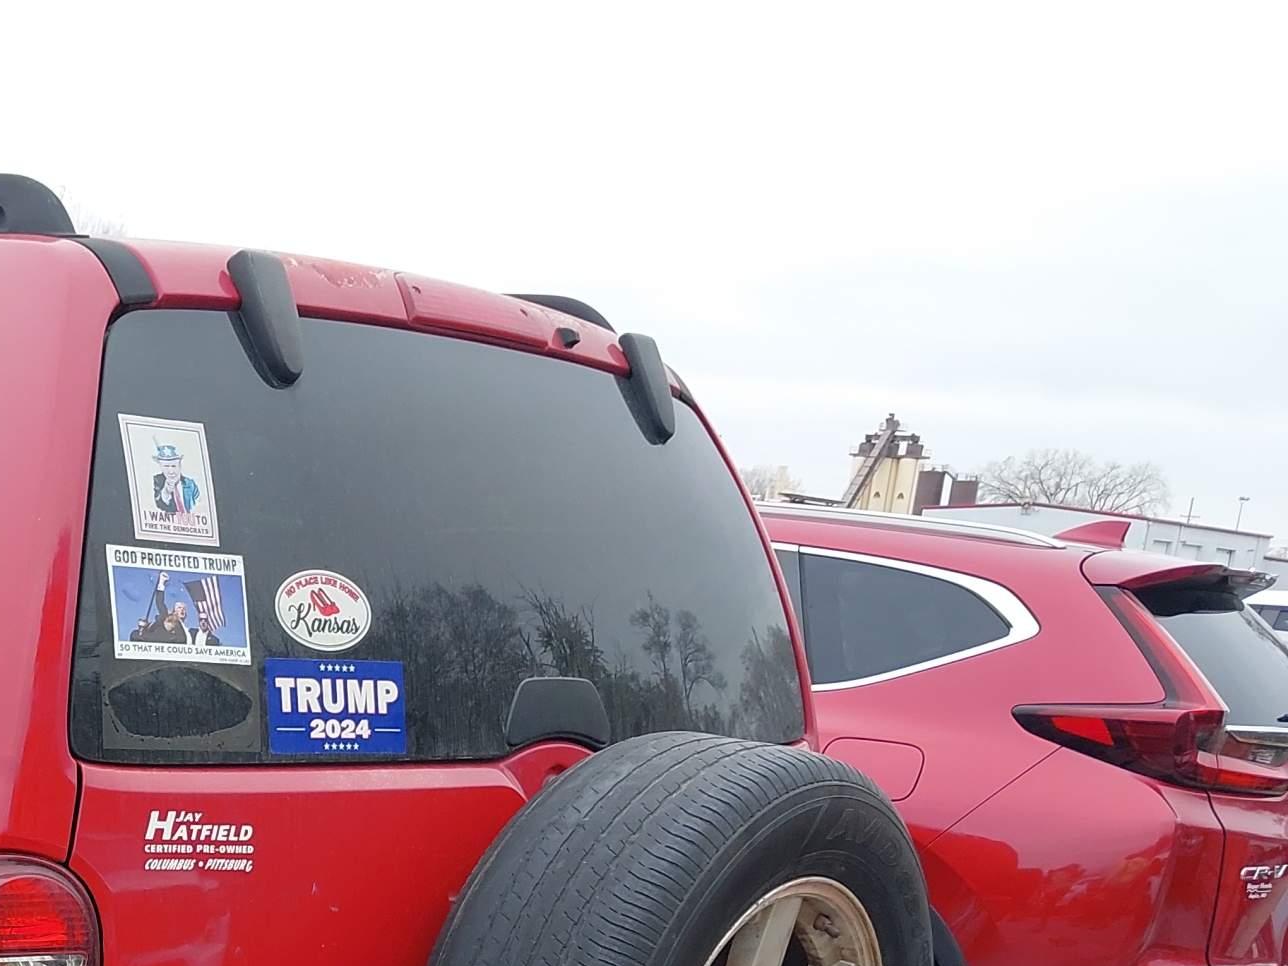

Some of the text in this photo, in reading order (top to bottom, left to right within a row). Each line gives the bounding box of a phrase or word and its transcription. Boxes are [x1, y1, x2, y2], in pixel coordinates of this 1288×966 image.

[149, 511, 176, 523] WANT
[196, 515, 208, 526] TO
[173, 525, 209, 534] DEMOCRATS
[114, 549, 237, 572] GOD PROTECTED TRUMP
[285, 576, 360, 602] NO PLACE LIKE HOME
[288, 603, 360, 637] Kansas
[119, 644, 247, 657] SO THAT HE COULD SAVE AMERICA
[274, 677, 399, 714] TRUMP
[309, 718, 371, 739] 2024
[175, 810, 202, 822] JAY
[144, 810, 253, 841] HATFIELD
[144, 844, 254, 854] CERTIFIED PRE-OWNED
[144, 859, 253, 873] COLUMBUS PITTSBURG
